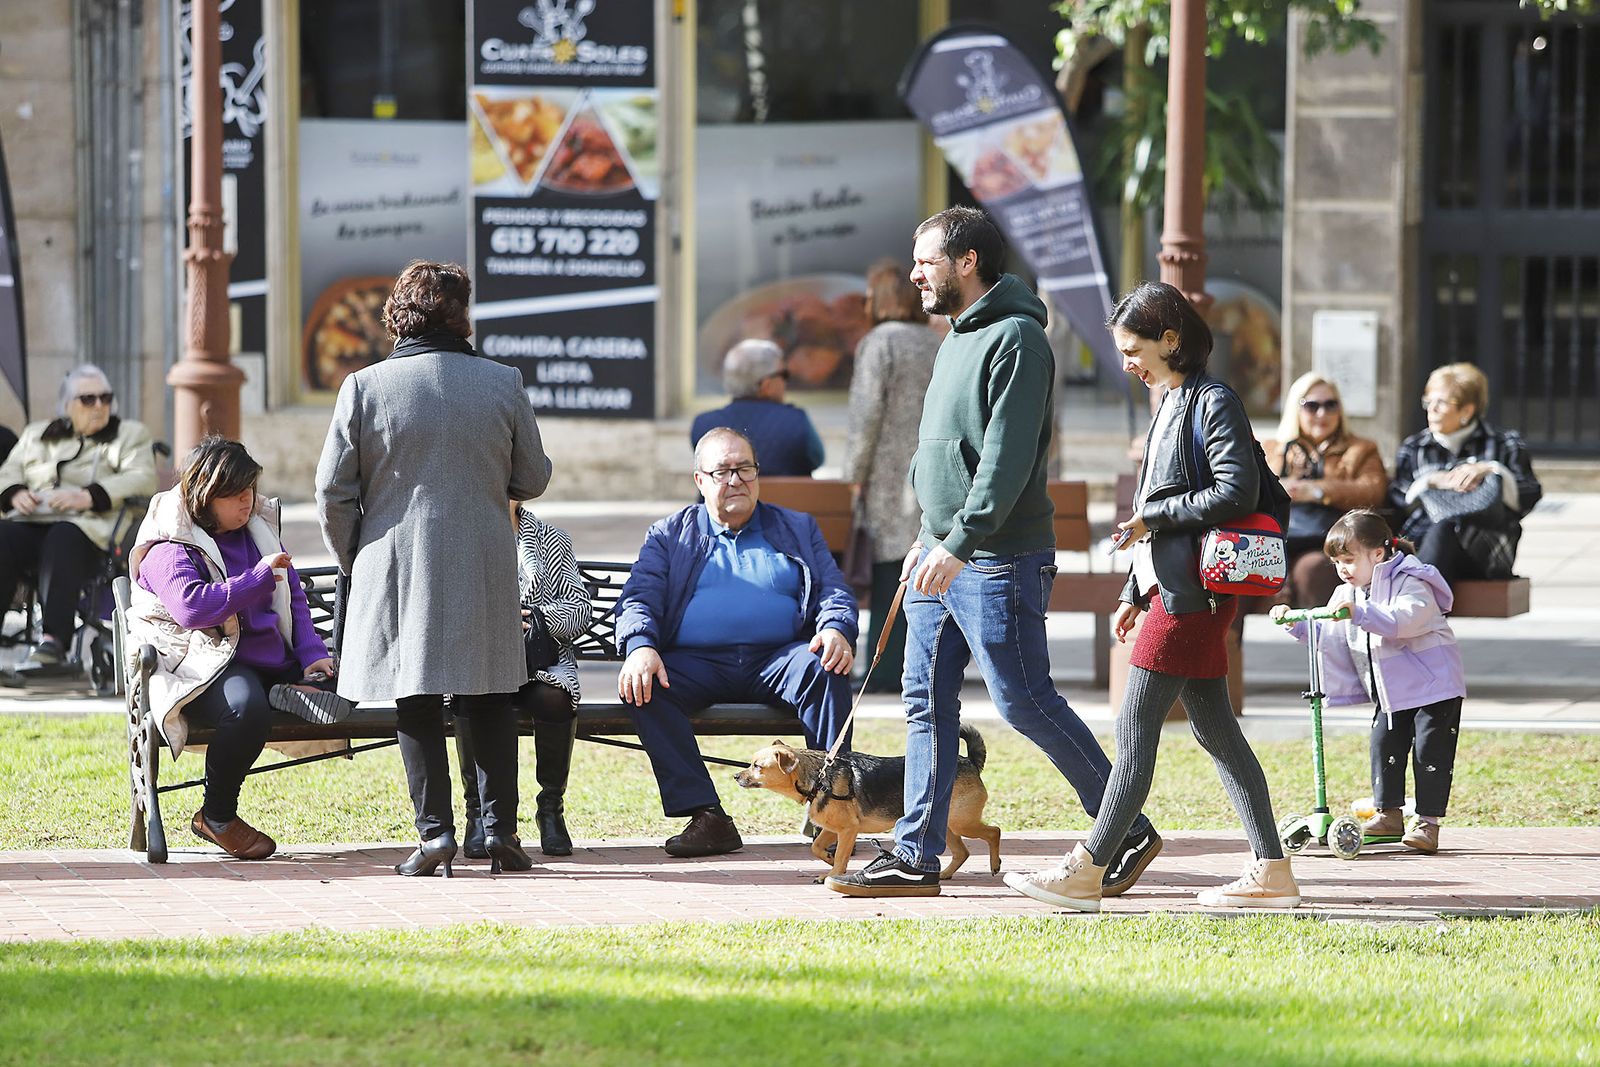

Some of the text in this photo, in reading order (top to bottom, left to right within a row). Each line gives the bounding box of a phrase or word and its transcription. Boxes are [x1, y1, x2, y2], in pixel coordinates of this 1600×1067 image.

[576, 40, 648, 64] SOLES
[490, 226, 640, 256] 613 710 220
[482, 334, 648, 360] COMIDA CASERA
[536, 361, 593, 383] LISTA
[555, 386, 632, 410] LLEVAR
[1244, 547, 1271, 559] Miss
[1249, 556, 1283, 569] Minnie
